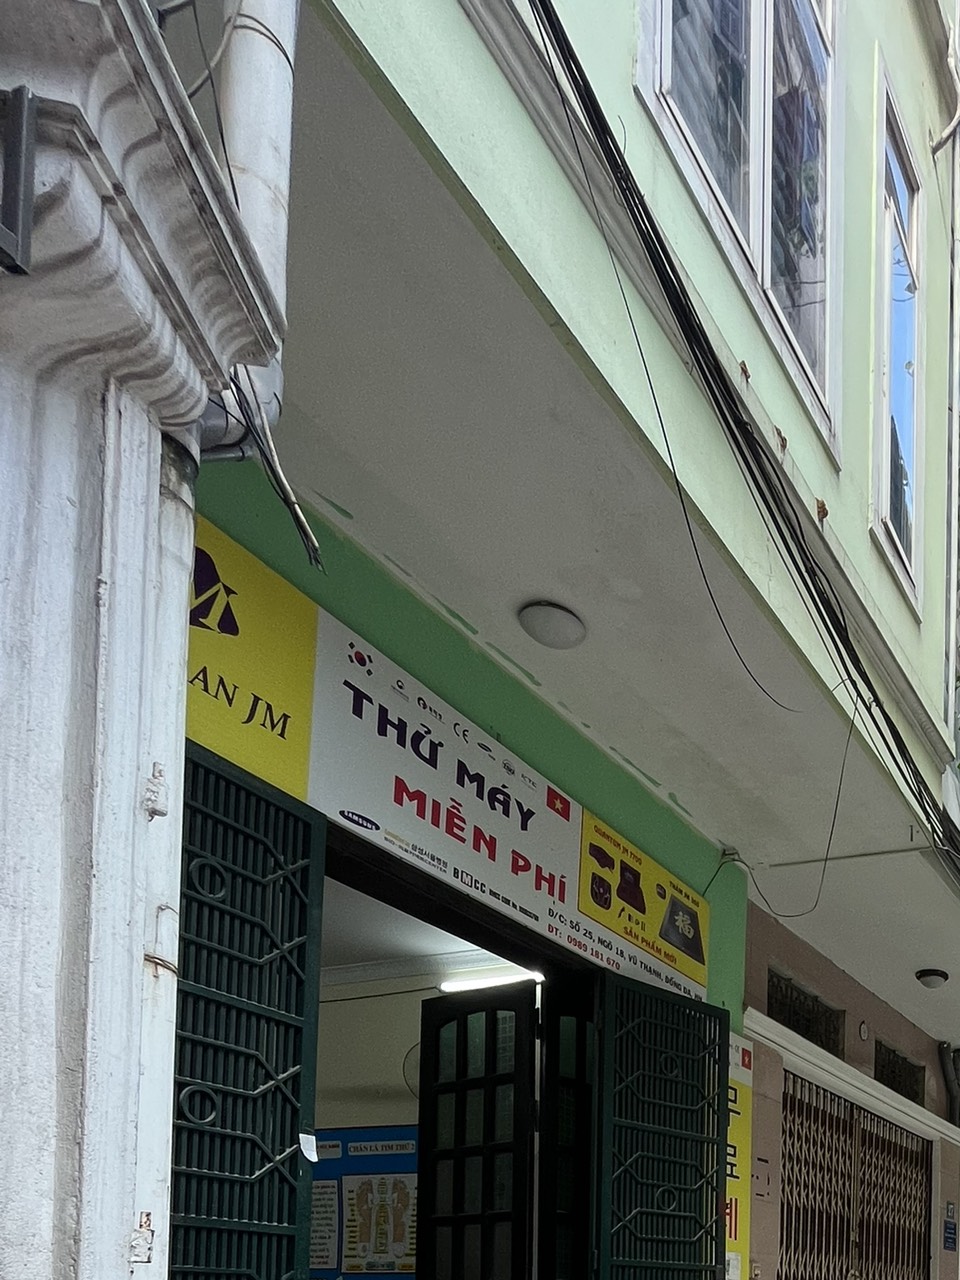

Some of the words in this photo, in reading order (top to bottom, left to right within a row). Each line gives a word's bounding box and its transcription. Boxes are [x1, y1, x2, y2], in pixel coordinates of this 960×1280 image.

[241, 692, 292, 740] JM
[342, 679, 444, 770] THỬ
[456, 758, 536, 831] MÁY
[344, 810, 377, 831] SAMSUNG
[392, 775, 497, 863] MIỄN
[511, 849, 567, 904] PHÍ
[453, 867, 486, 894] BMCC
[548, 907, 567, 926] Đ/C:
[569, 919, 581, 932] SỐ
[583, 928, 596, 943] 25,
[598, 936, 613, 951] NGÕ
[616, 947, 626, 960] 18,
[567, 934, 588, 953] 0989
[590, 947, 604, 962] 181
[606, 957, 621, 970] 670
[623, 926, 639, 941] SẢN
